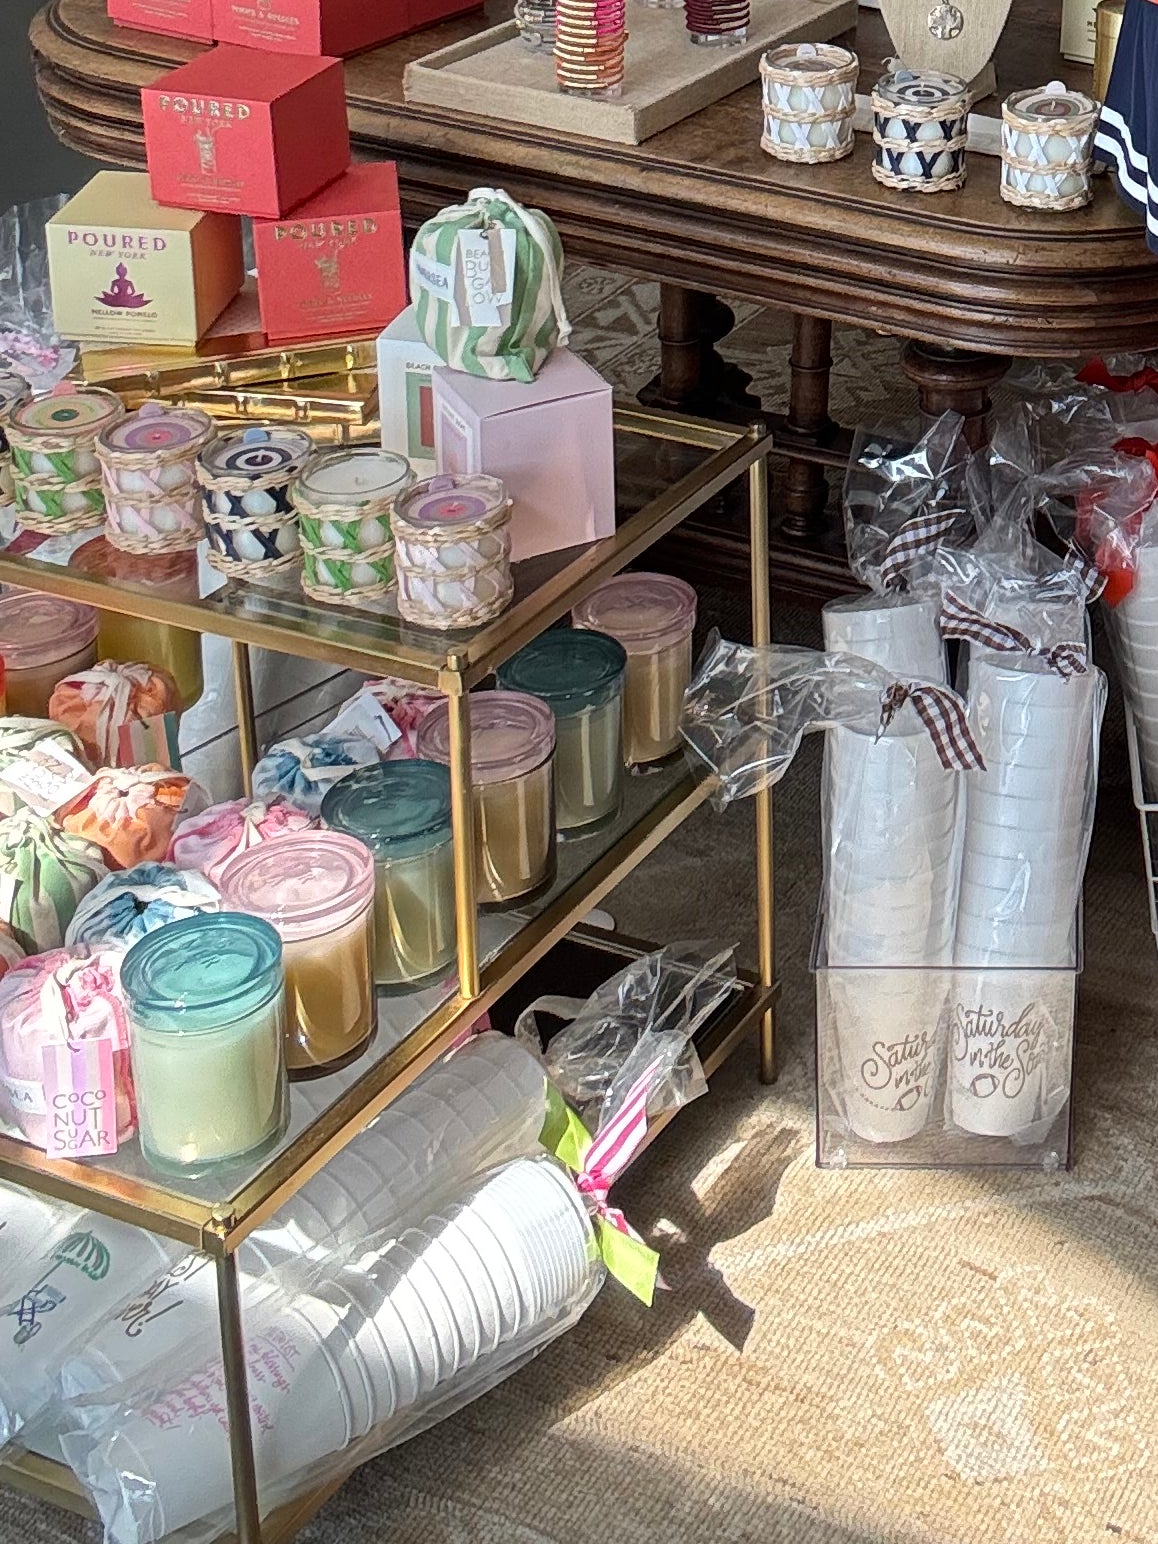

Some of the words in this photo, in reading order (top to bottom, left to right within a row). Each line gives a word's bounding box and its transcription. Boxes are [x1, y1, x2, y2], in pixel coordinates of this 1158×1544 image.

[159, 94, 250, 120] POURED
[67, 229, 167, 252] POURED
[274, 217, 378, 241] POURED
[465, 248, 489, 259] BEA
[951, 1002, 1044, 1062] Saturday
[983, 1039, 1014, 1071] the
[54, 1106, 103, 1130] NUT
[53, 1128, 111, 1151] SUGAR
